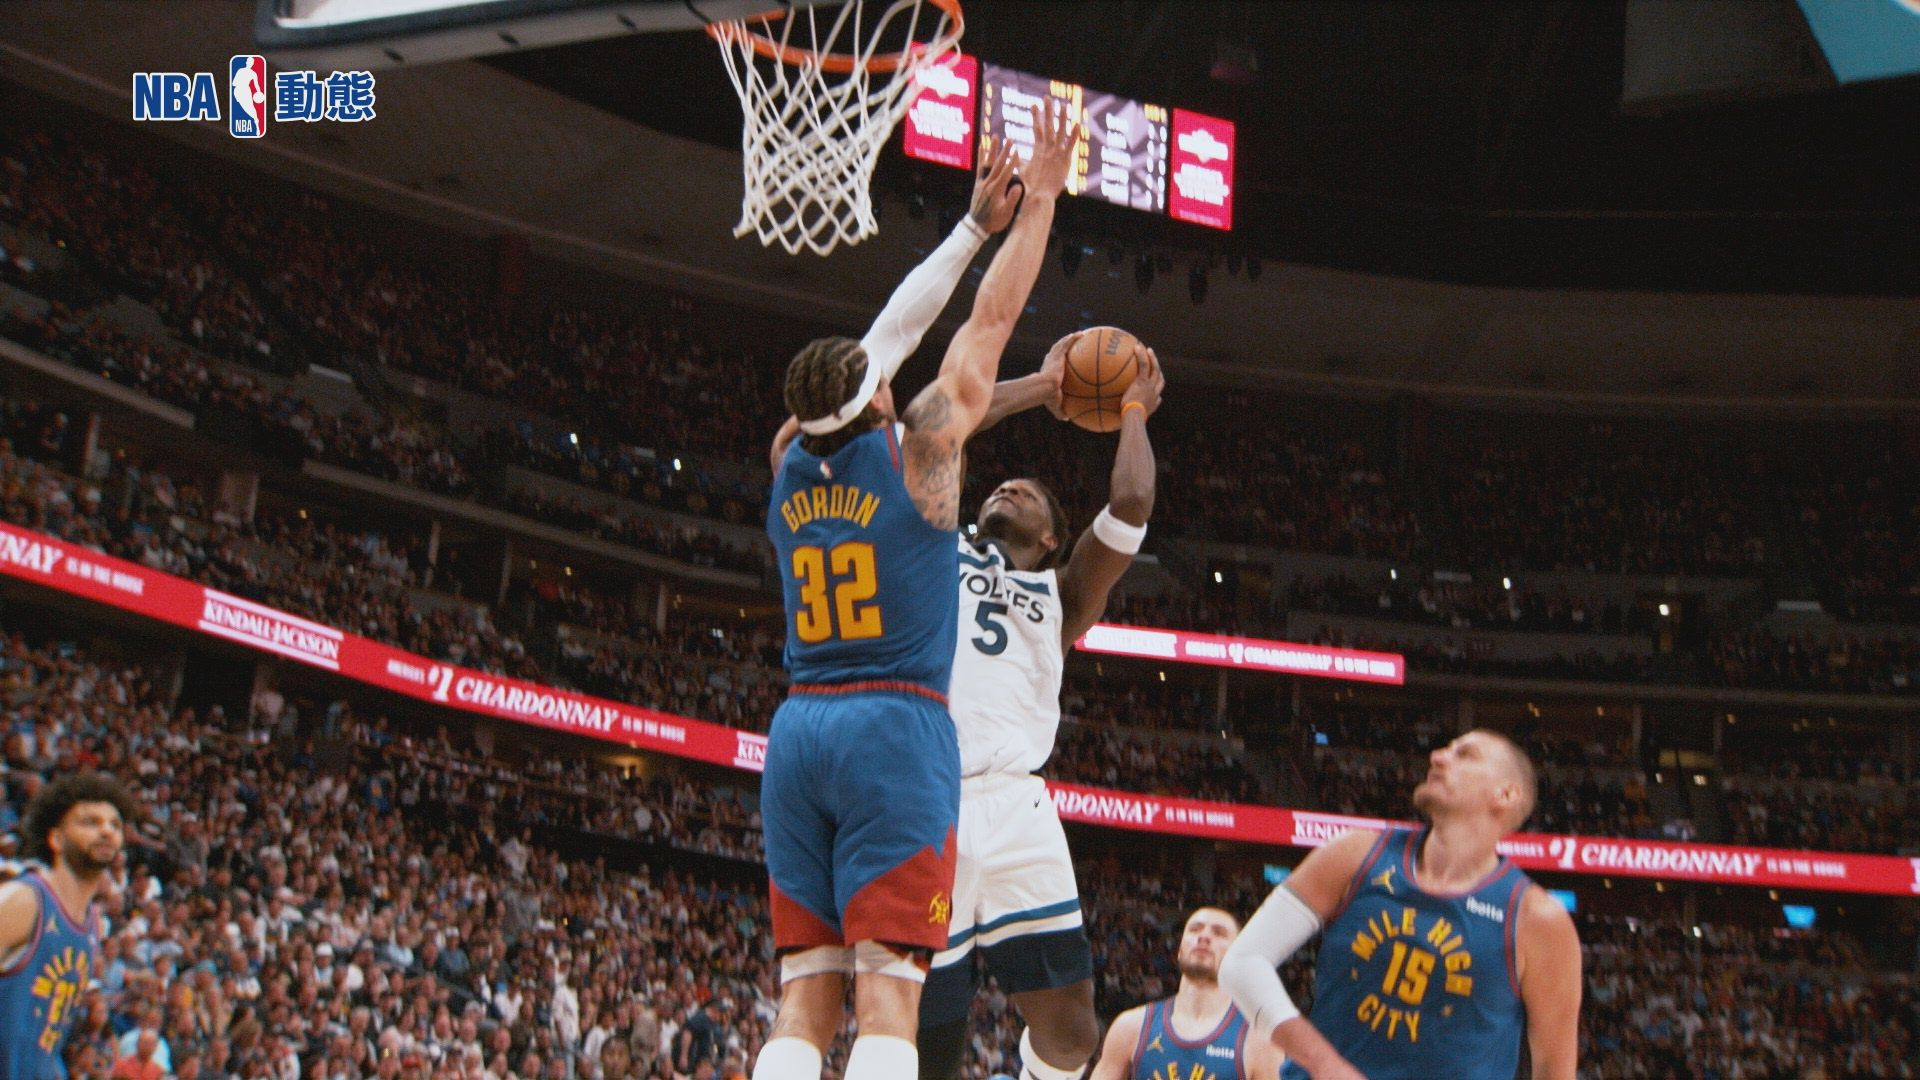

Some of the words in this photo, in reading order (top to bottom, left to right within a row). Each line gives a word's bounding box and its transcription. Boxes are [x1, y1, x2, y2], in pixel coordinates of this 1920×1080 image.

[780, 484, 880, 533] GORDON
[791, 541, 884, 645] 32
[959, 572, 1044, 624] OLES
[203, 598, 340, 661] KENDALL-JACKSON
[971, 600, 1009, 656] 5
[455, 675, 619, 732] CHARDONNAY
[1047, 788, 1161, 825] RDONNAY
[1581, 843, 1761, 877] CHARDONNAY
[1351, 907, 1416, 962] MILE
[1426, 916, 1473, 998] HIGH
[1381, 941, 1436, 1005] 15
[1357, 993, 1421, 1043] CITY
